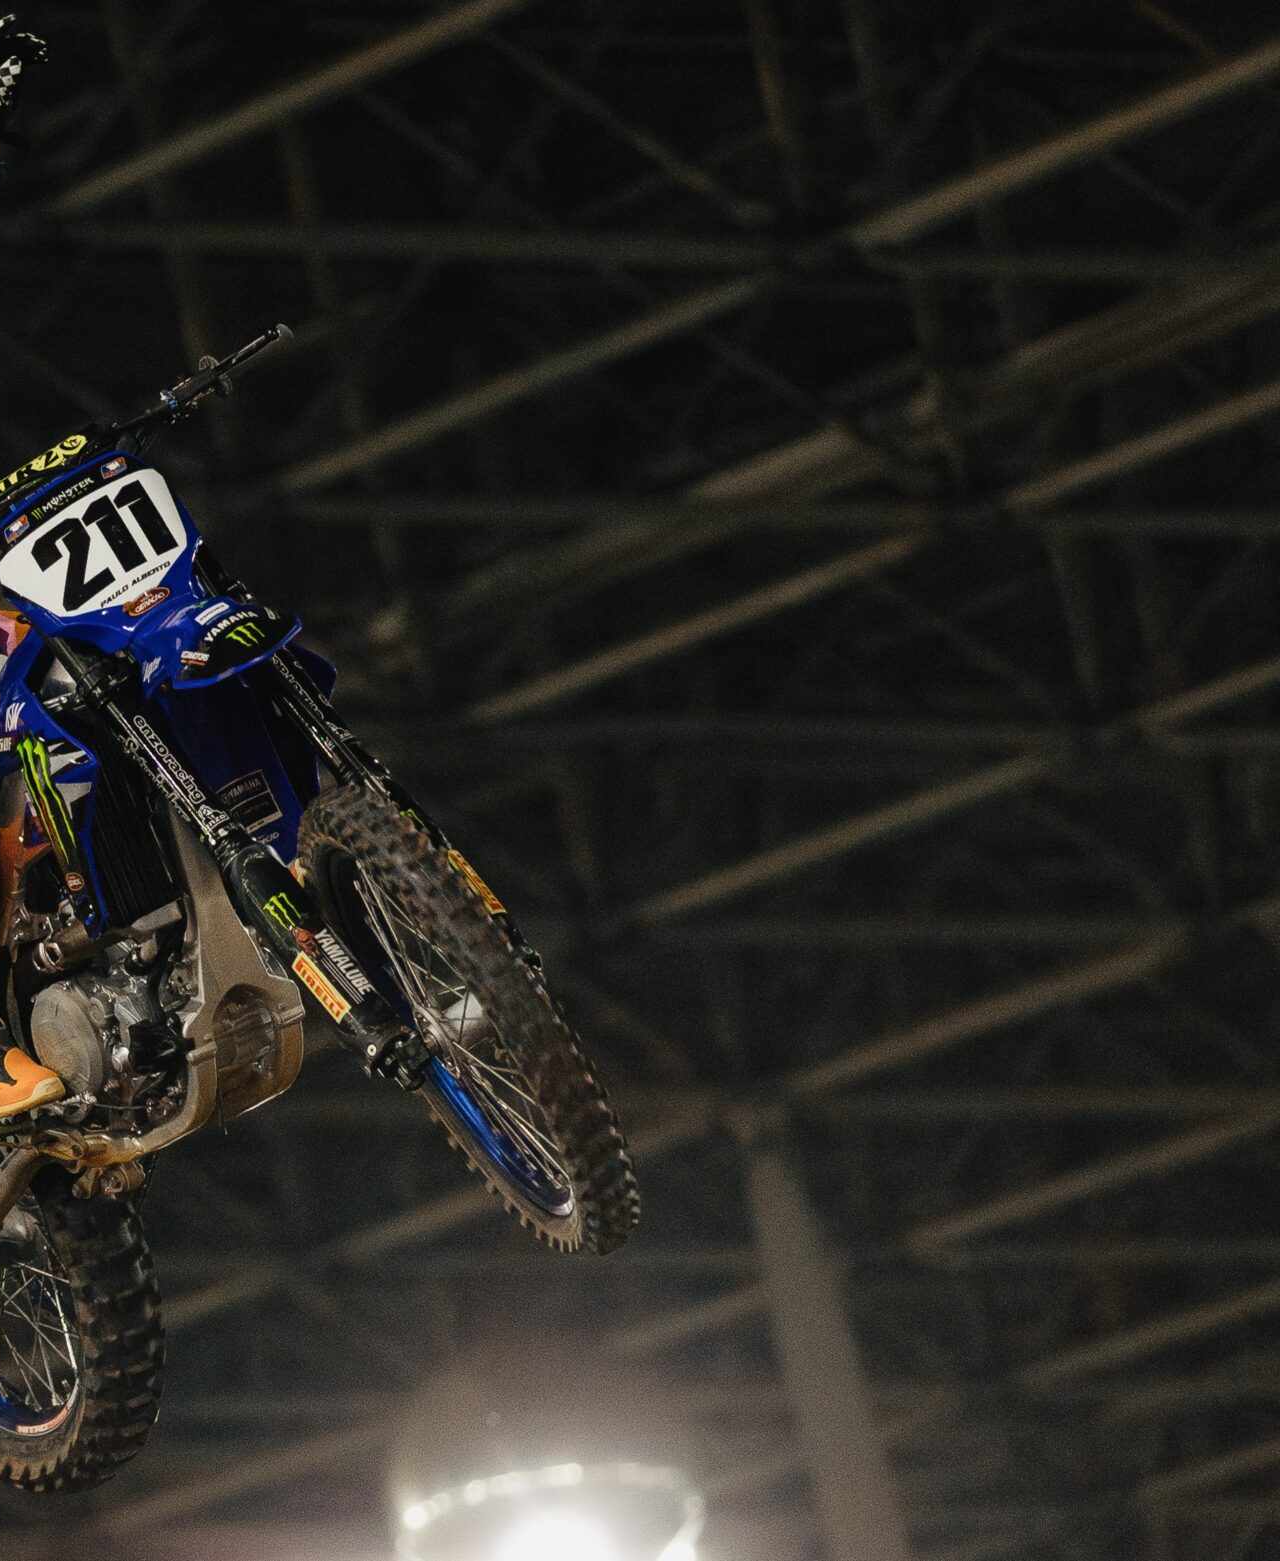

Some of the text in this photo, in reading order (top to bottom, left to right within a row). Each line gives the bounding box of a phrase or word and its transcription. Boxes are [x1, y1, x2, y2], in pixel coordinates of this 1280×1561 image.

[41, 476, 95, 514] MONSTER
[30, 479, 179, 612] 211
[100, 560, 171, 608] PAULO ALBERTO
[203, 610, 259, 643] YAMAHA
[294, 956, 346, 1019] PIRELLI
[314, 928, 372, 996] YAMALUBE
